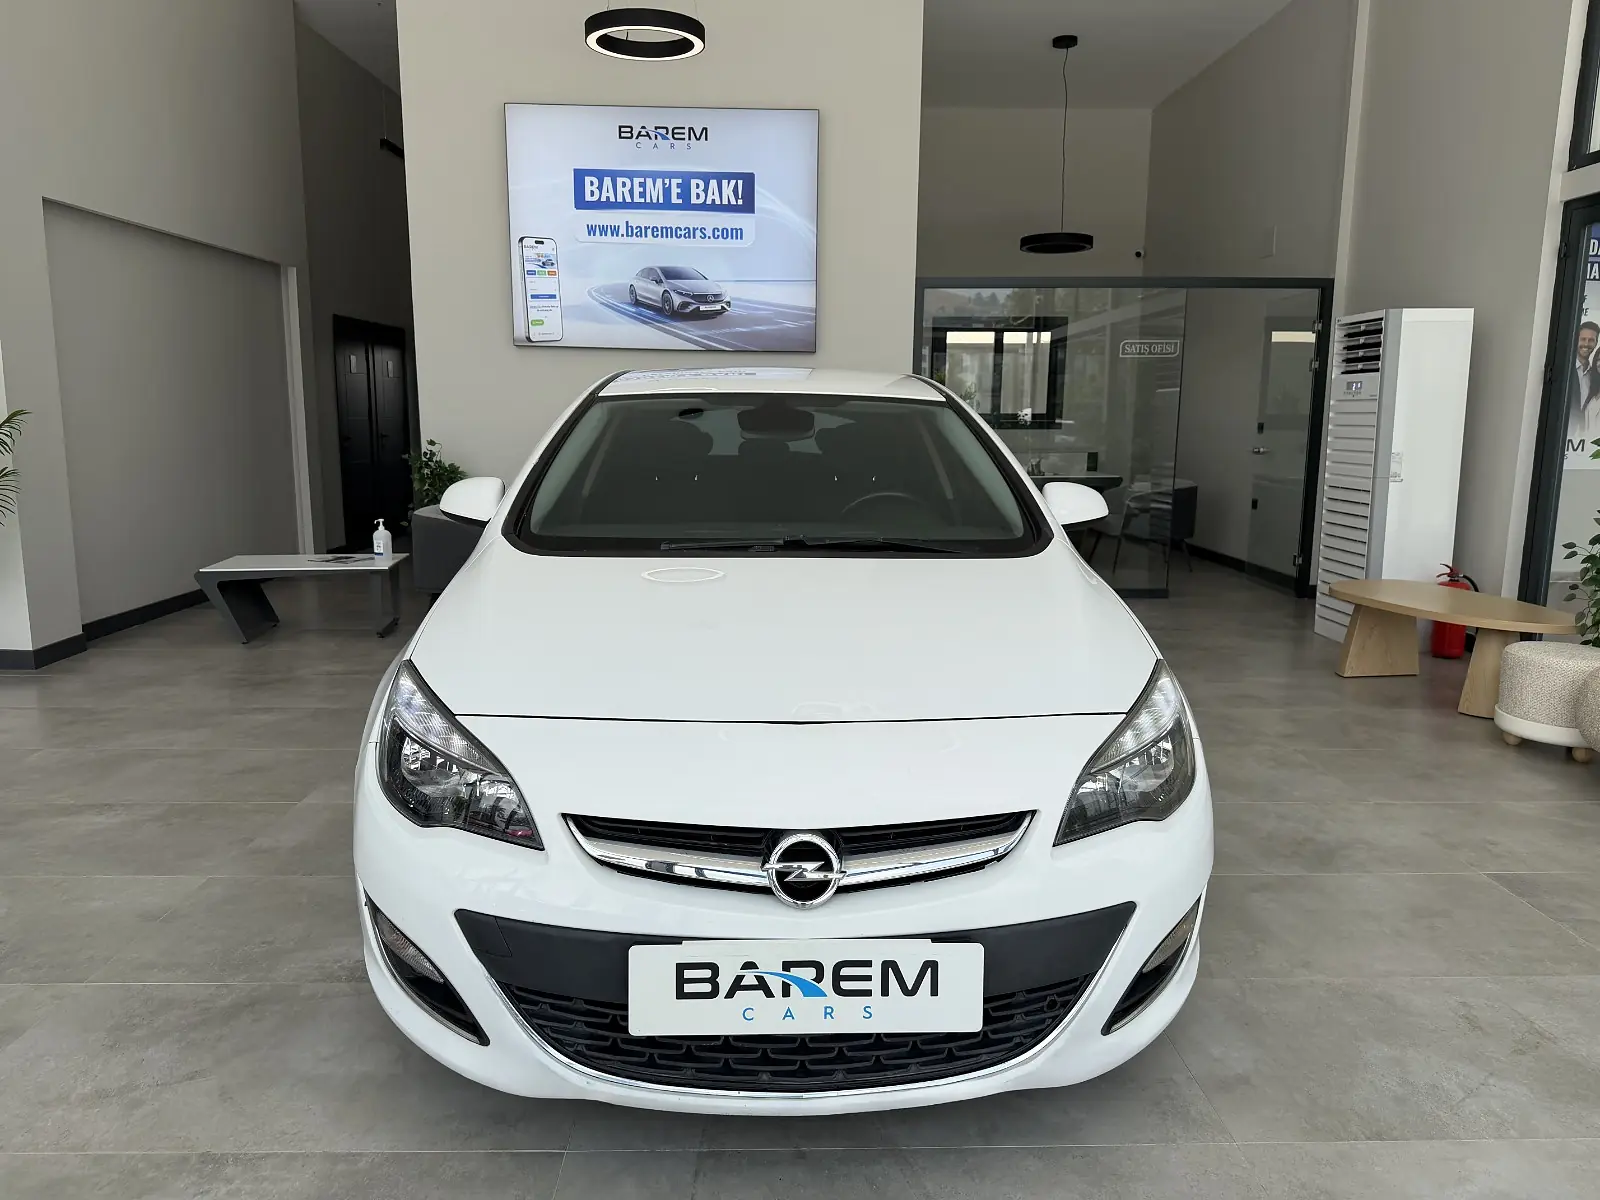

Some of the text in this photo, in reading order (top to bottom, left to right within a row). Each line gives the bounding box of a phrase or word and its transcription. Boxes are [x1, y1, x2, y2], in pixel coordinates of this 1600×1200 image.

[618, 125, 709, 141] BAREM
[635, 142, 692, 150] CARS
[690, 179, 744, 205] BAK!
[586, 221, 744, 241] www.baremcars.com
[675, 959, 939, 1000] BAREM
[742, 1005, 873, 1022] CARS
